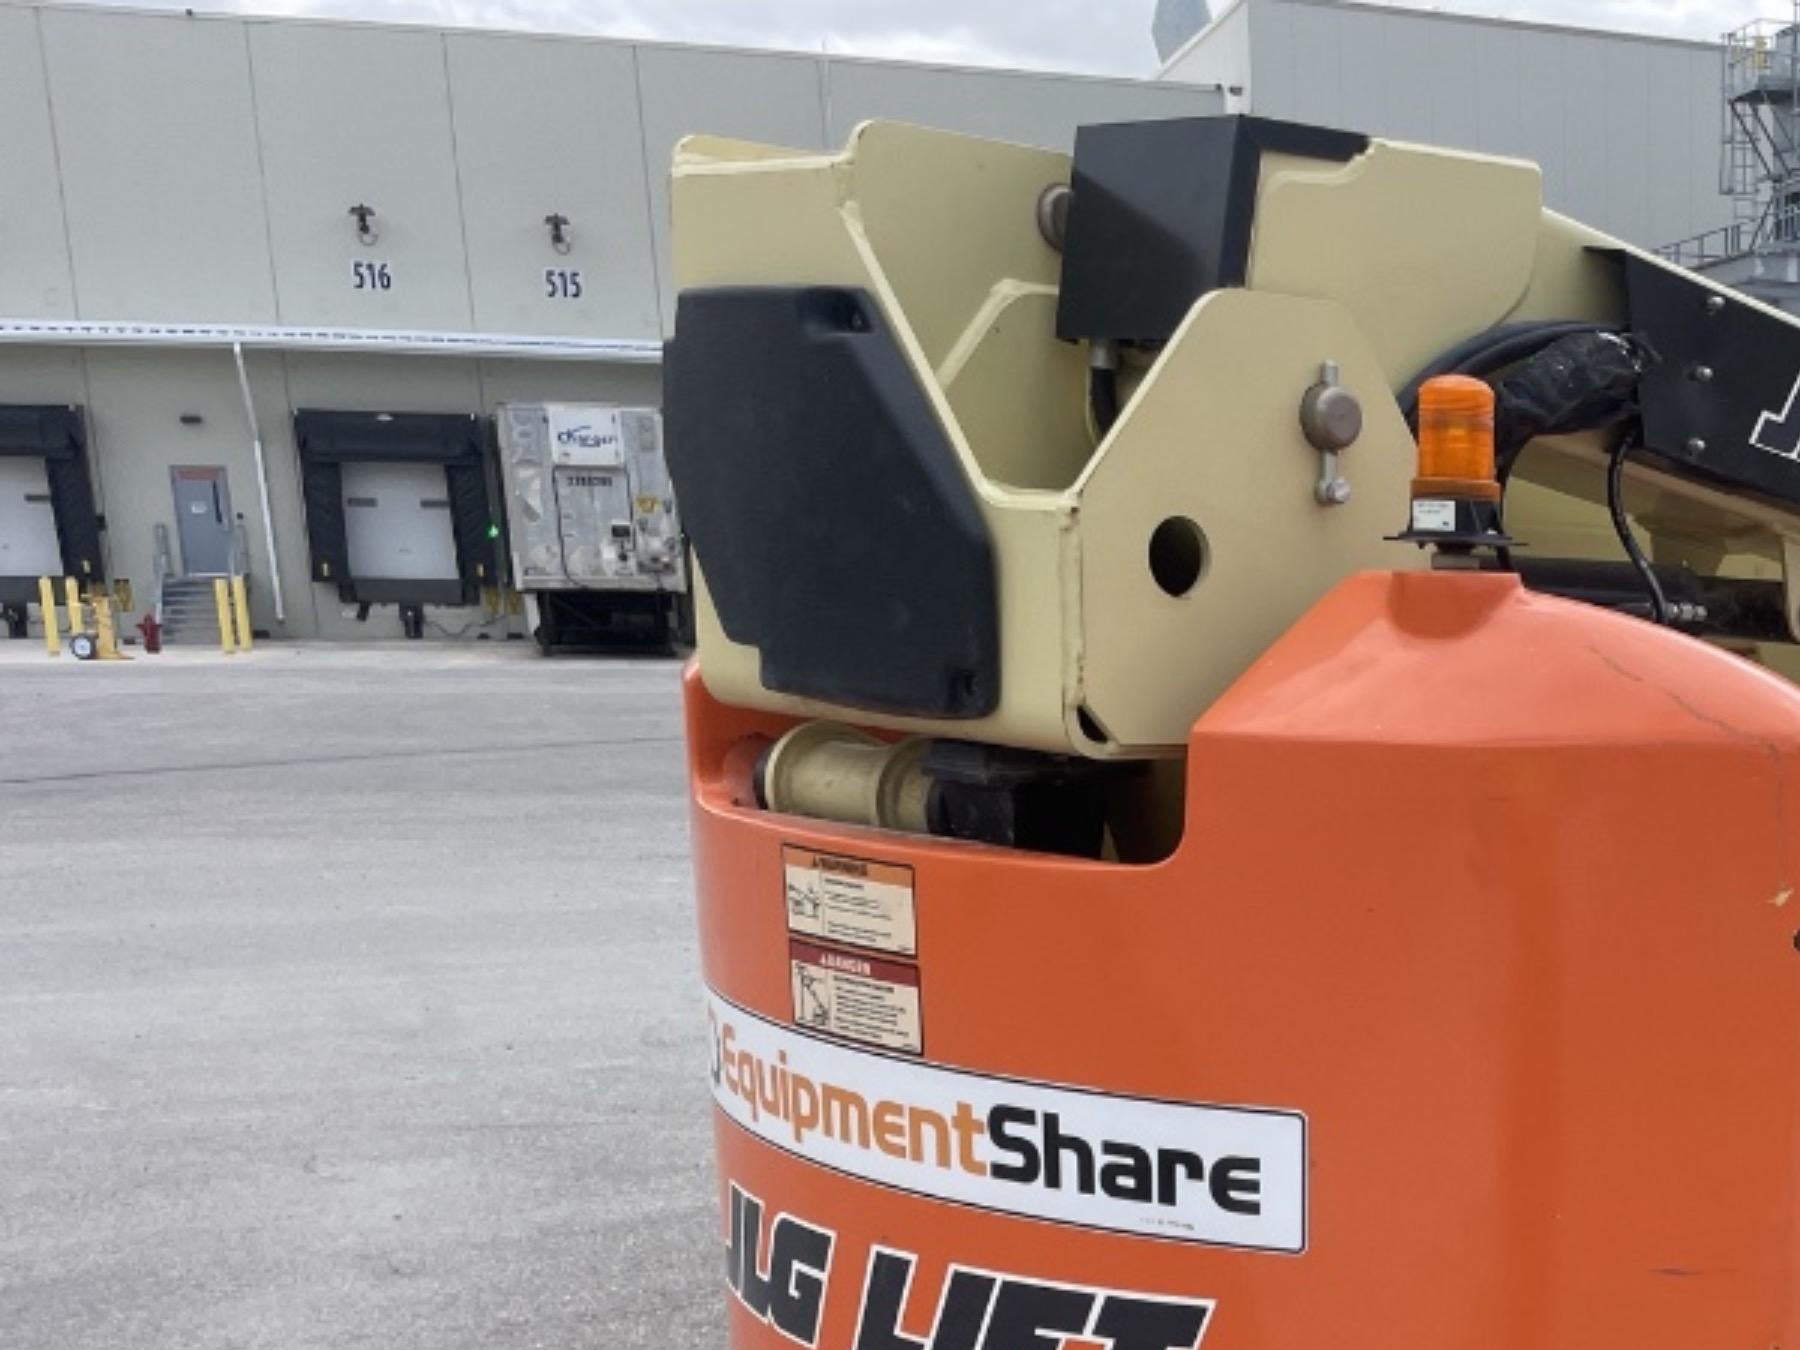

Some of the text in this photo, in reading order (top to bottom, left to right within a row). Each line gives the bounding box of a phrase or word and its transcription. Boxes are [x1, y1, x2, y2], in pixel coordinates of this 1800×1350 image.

[352, 260, 392, 290] 516
[544, 268, 582, 299] 515
[722, 1022, 1262, 1217] EquipmentShare
[725, 1179, 836, 1350] JLG
